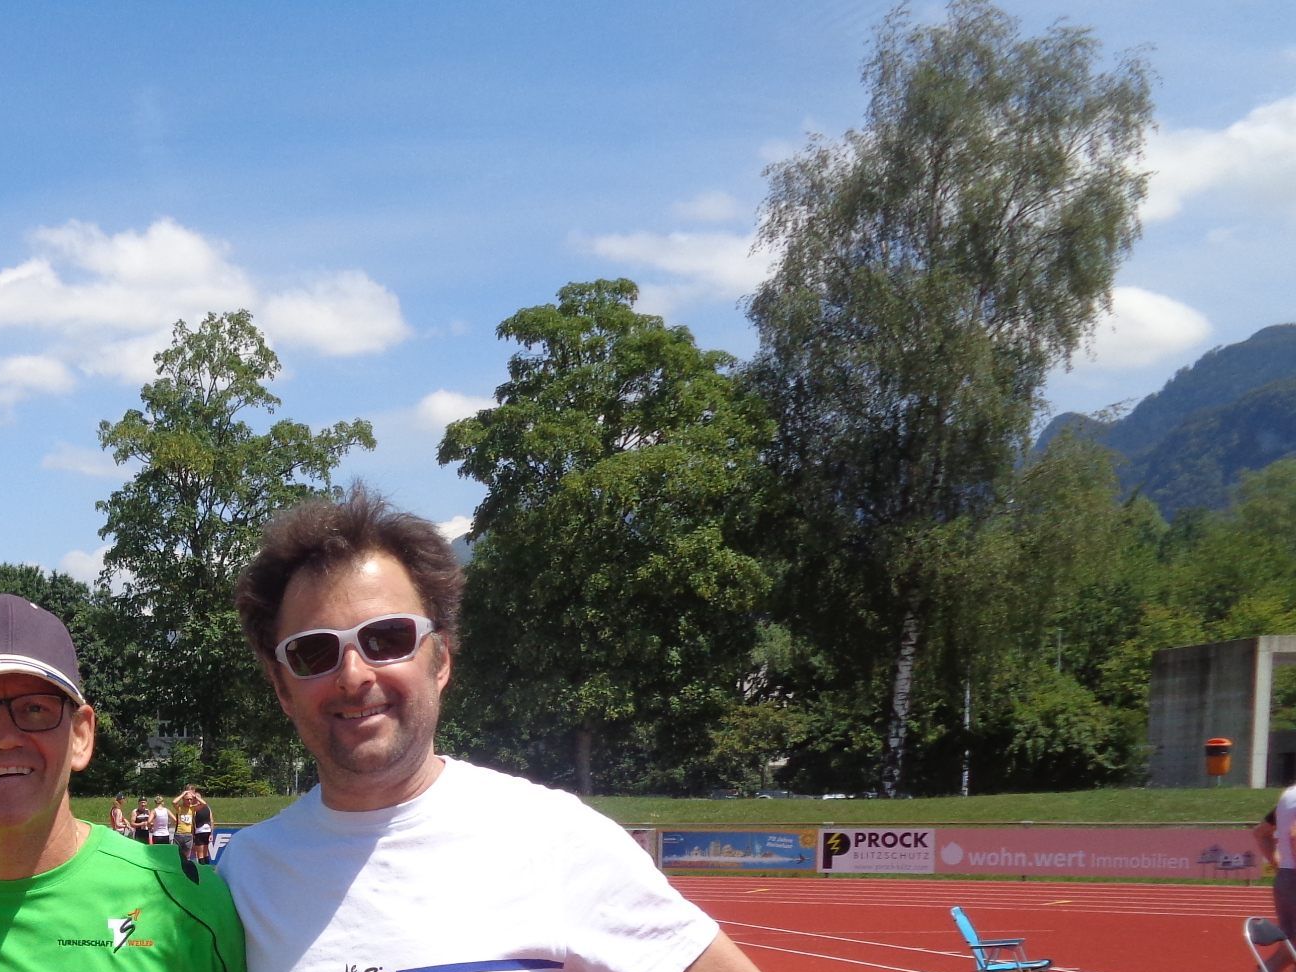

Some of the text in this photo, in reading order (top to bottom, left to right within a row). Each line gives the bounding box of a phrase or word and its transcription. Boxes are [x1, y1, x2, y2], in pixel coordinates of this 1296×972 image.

[854, 832, 929, 849] PROCK
[853, 851, 929, 860] BLITZSCHUTZ
[968, 848, 1190, 870] wohn.wert Immobilien
[57, 938, 113, 948] TURNERSCHAFT
